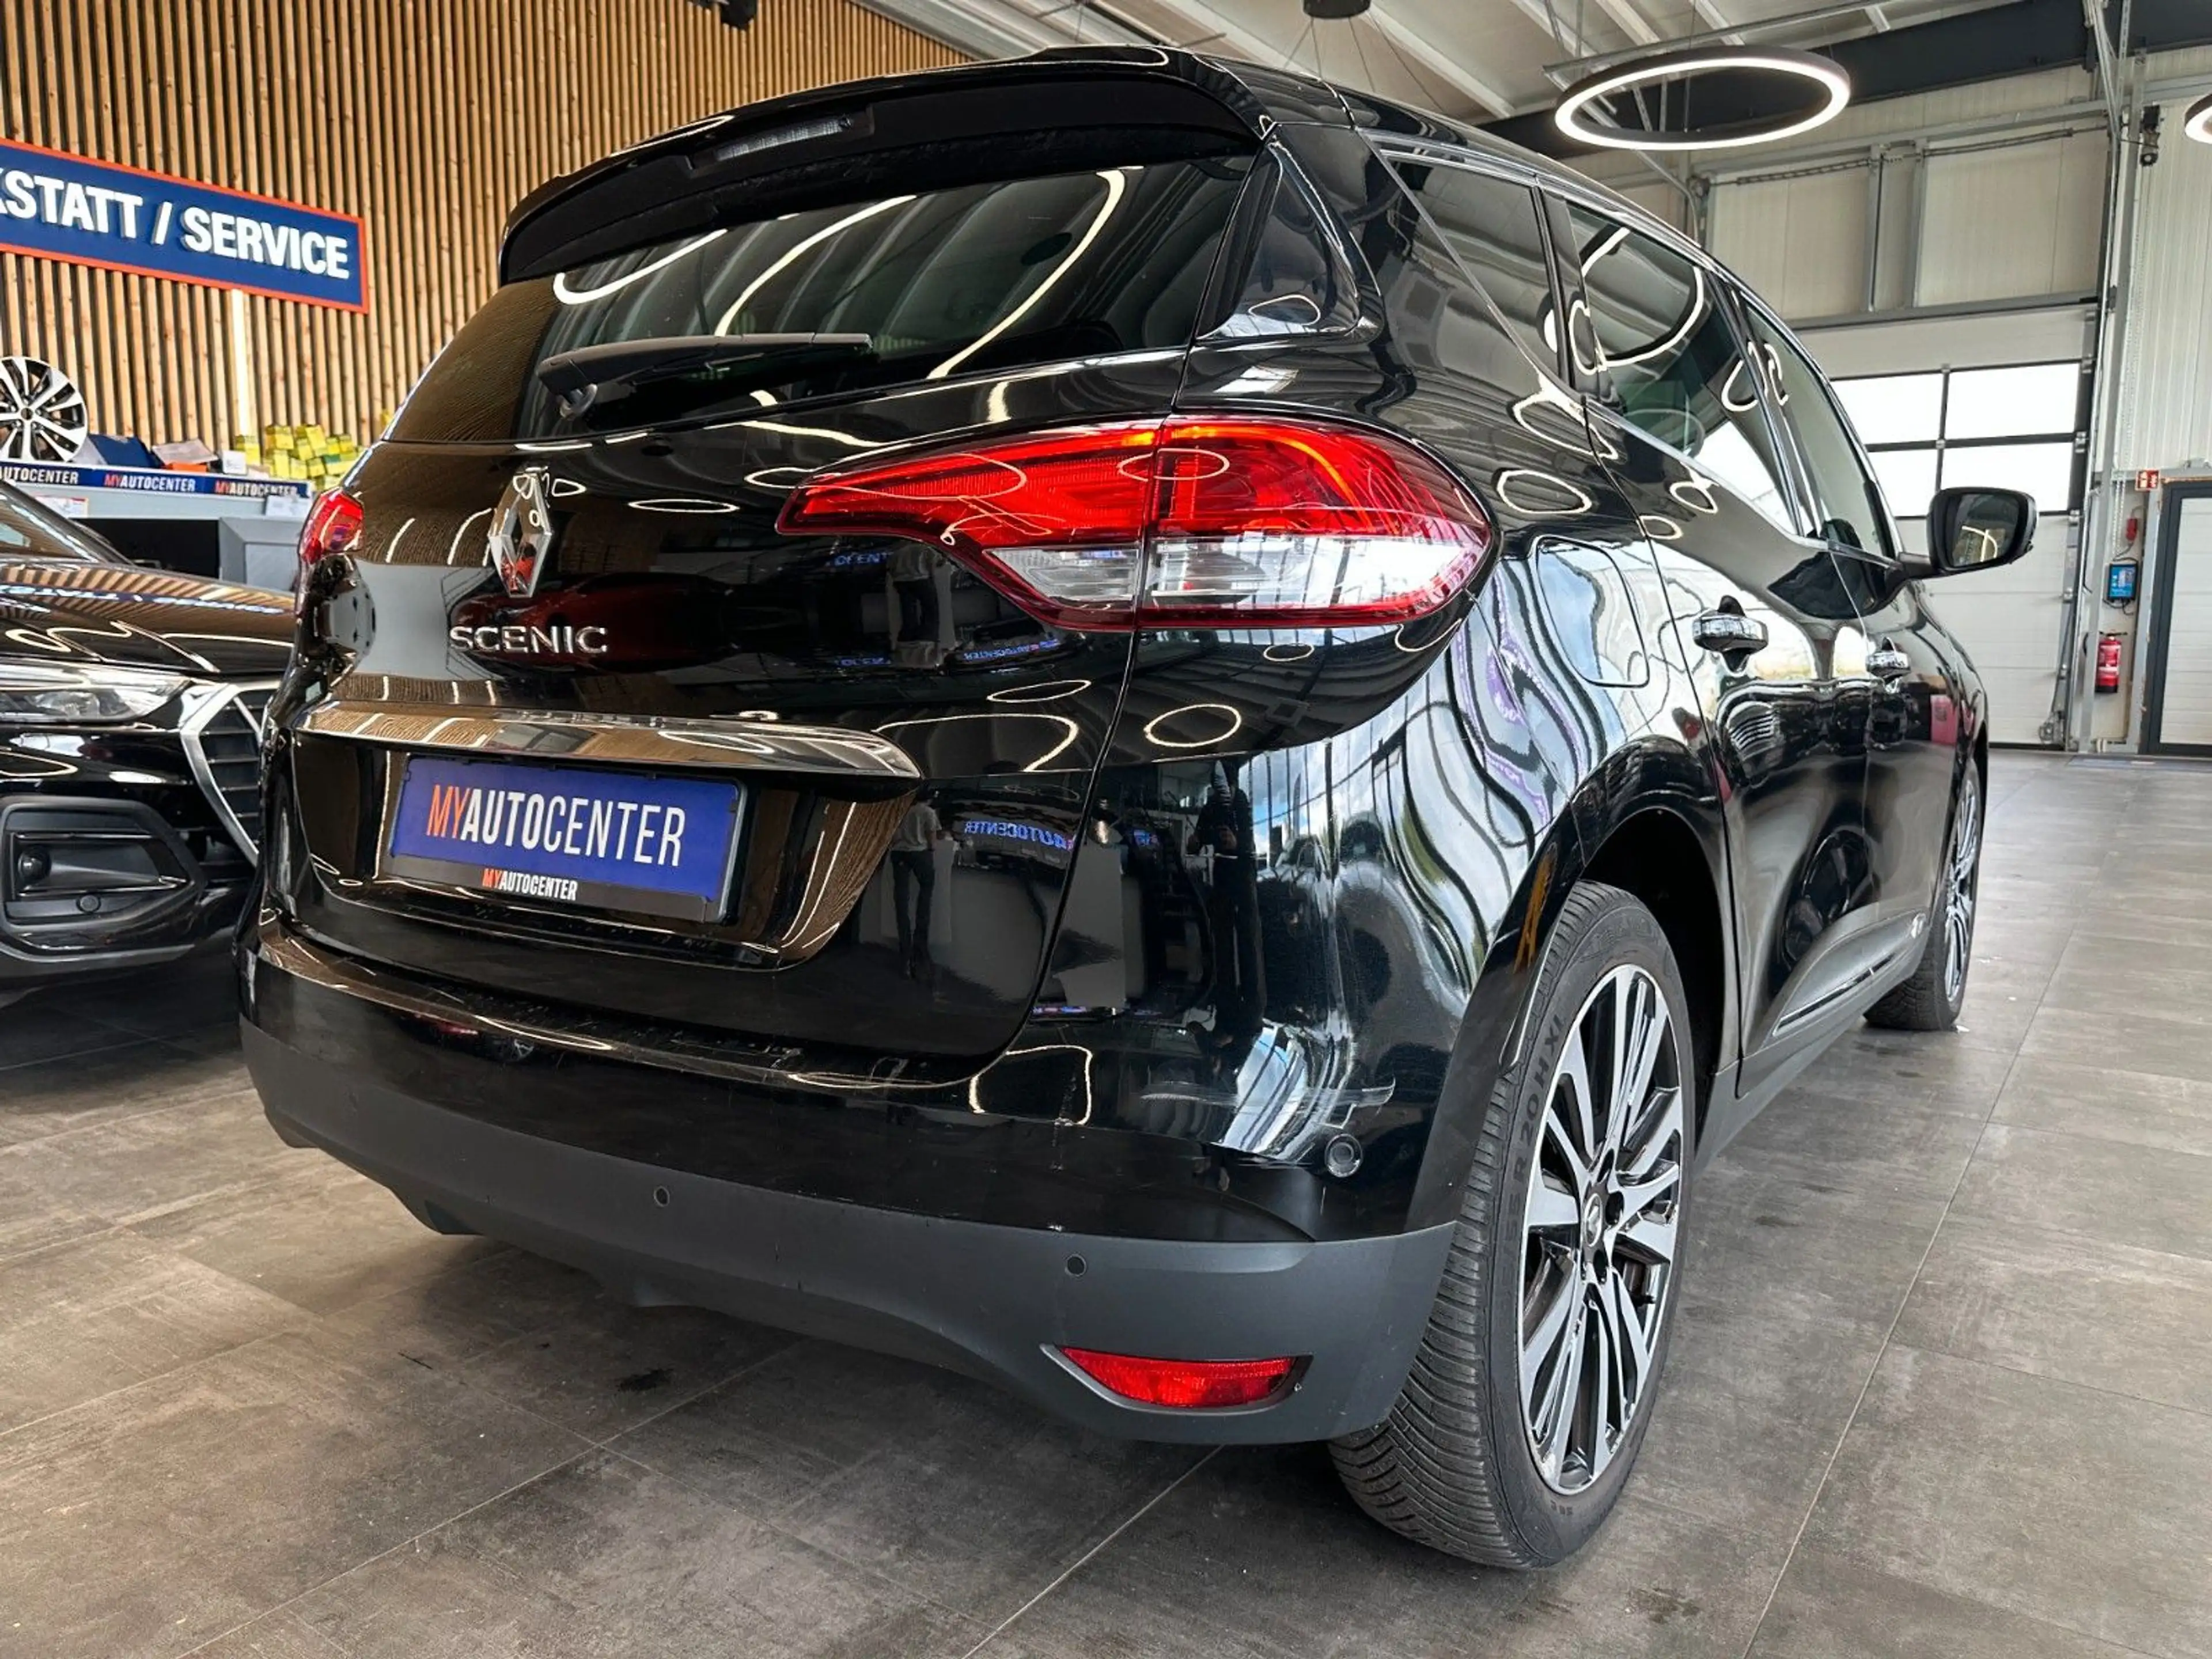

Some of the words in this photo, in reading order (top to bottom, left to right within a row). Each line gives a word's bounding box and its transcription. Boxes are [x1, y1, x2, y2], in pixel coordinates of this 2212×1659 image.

[151, 201, 173, 245] /
[181, 206, 350, 279] SERVICE
[104, 472, 196, 492] MYAUTOCENTER
[449, 626, 607, 654] SCENIC
[426, 784, 686, 867] MYAUTOCENTER
[482, 868, 578, 901] MYAUTOCENTER
